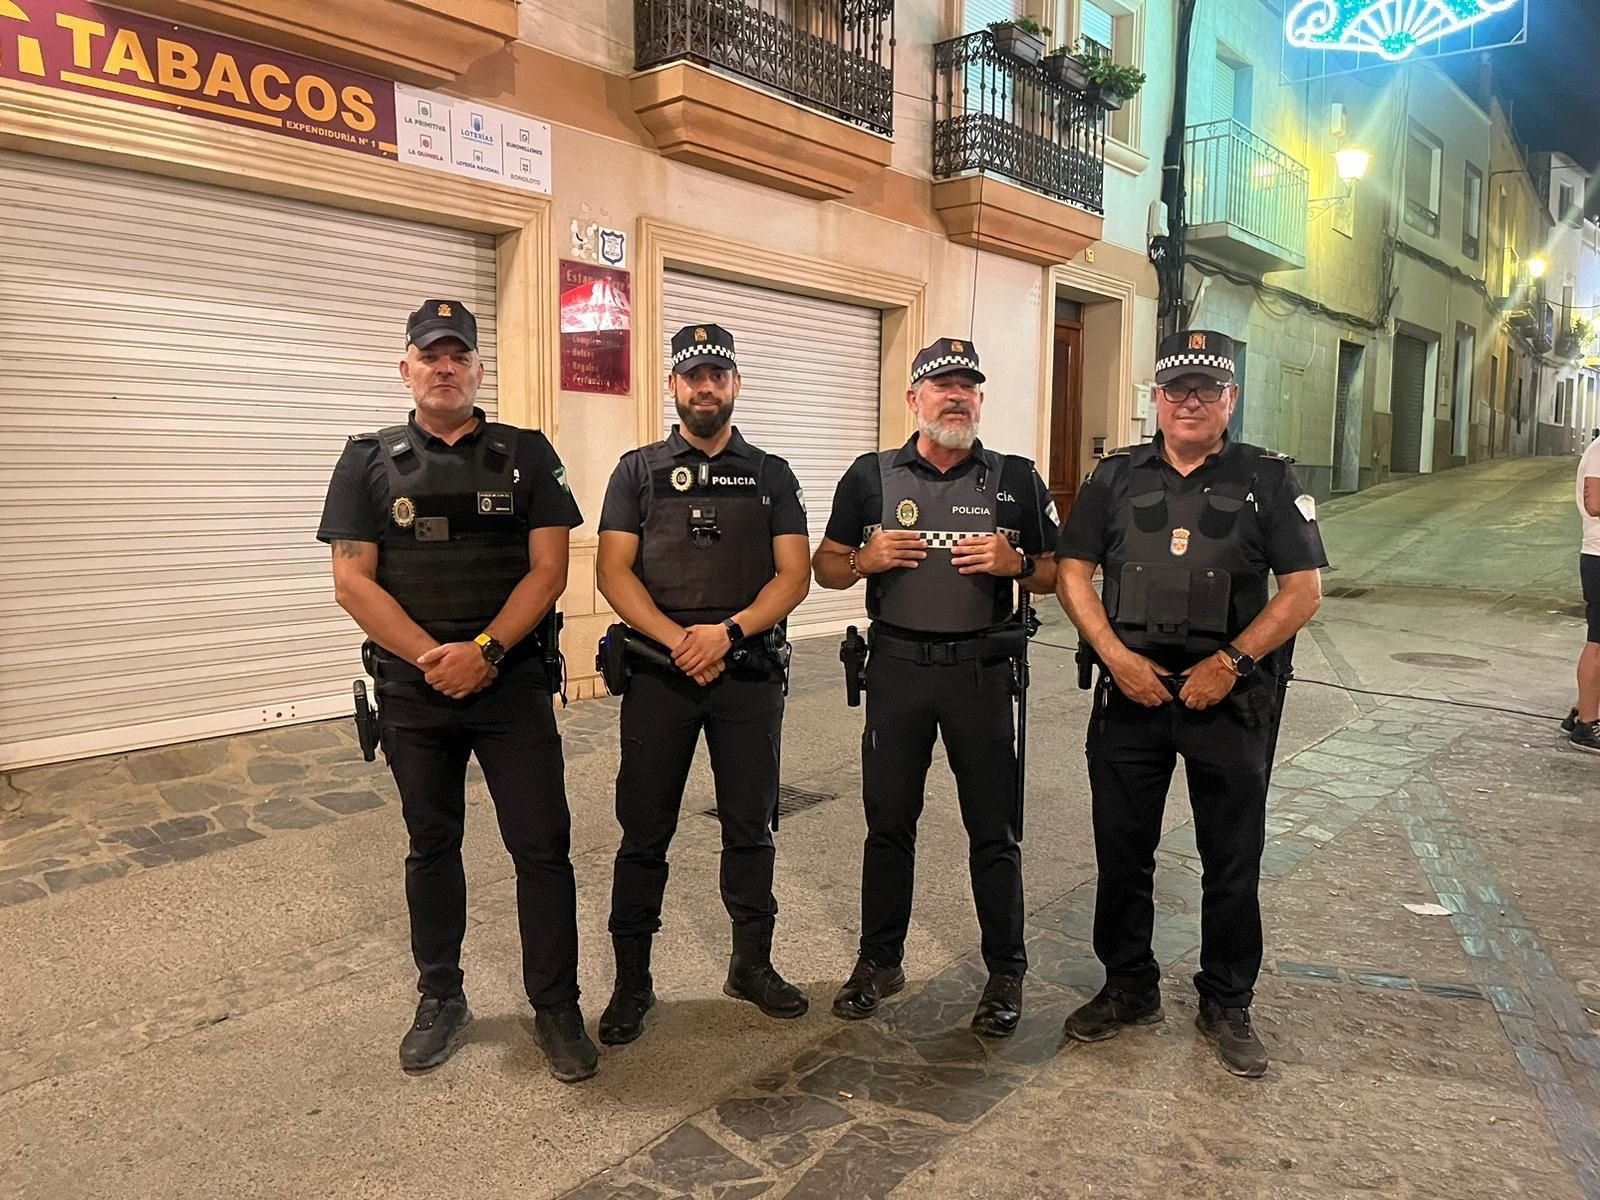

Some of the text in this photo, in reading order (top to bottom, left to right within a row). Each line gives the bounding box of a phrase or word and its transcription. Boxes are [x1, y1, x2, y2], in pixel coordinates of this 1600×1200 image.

[55, 12, 377, 132] TABACOS
[404, 116, 446, 132] LA PRIMITIVA
[460, 129, 494, 143] LOTERÍAS
[370, 140, 376, 148] 1
[506, 141, 543, 156] EUROMILLONES
[408, 148, 416, 156] LA
[510, 174, 541, 186] BONOLOTO
[712, 476, 756, 485] POLICIA
[952, 506, 991, 515] POLICIA
